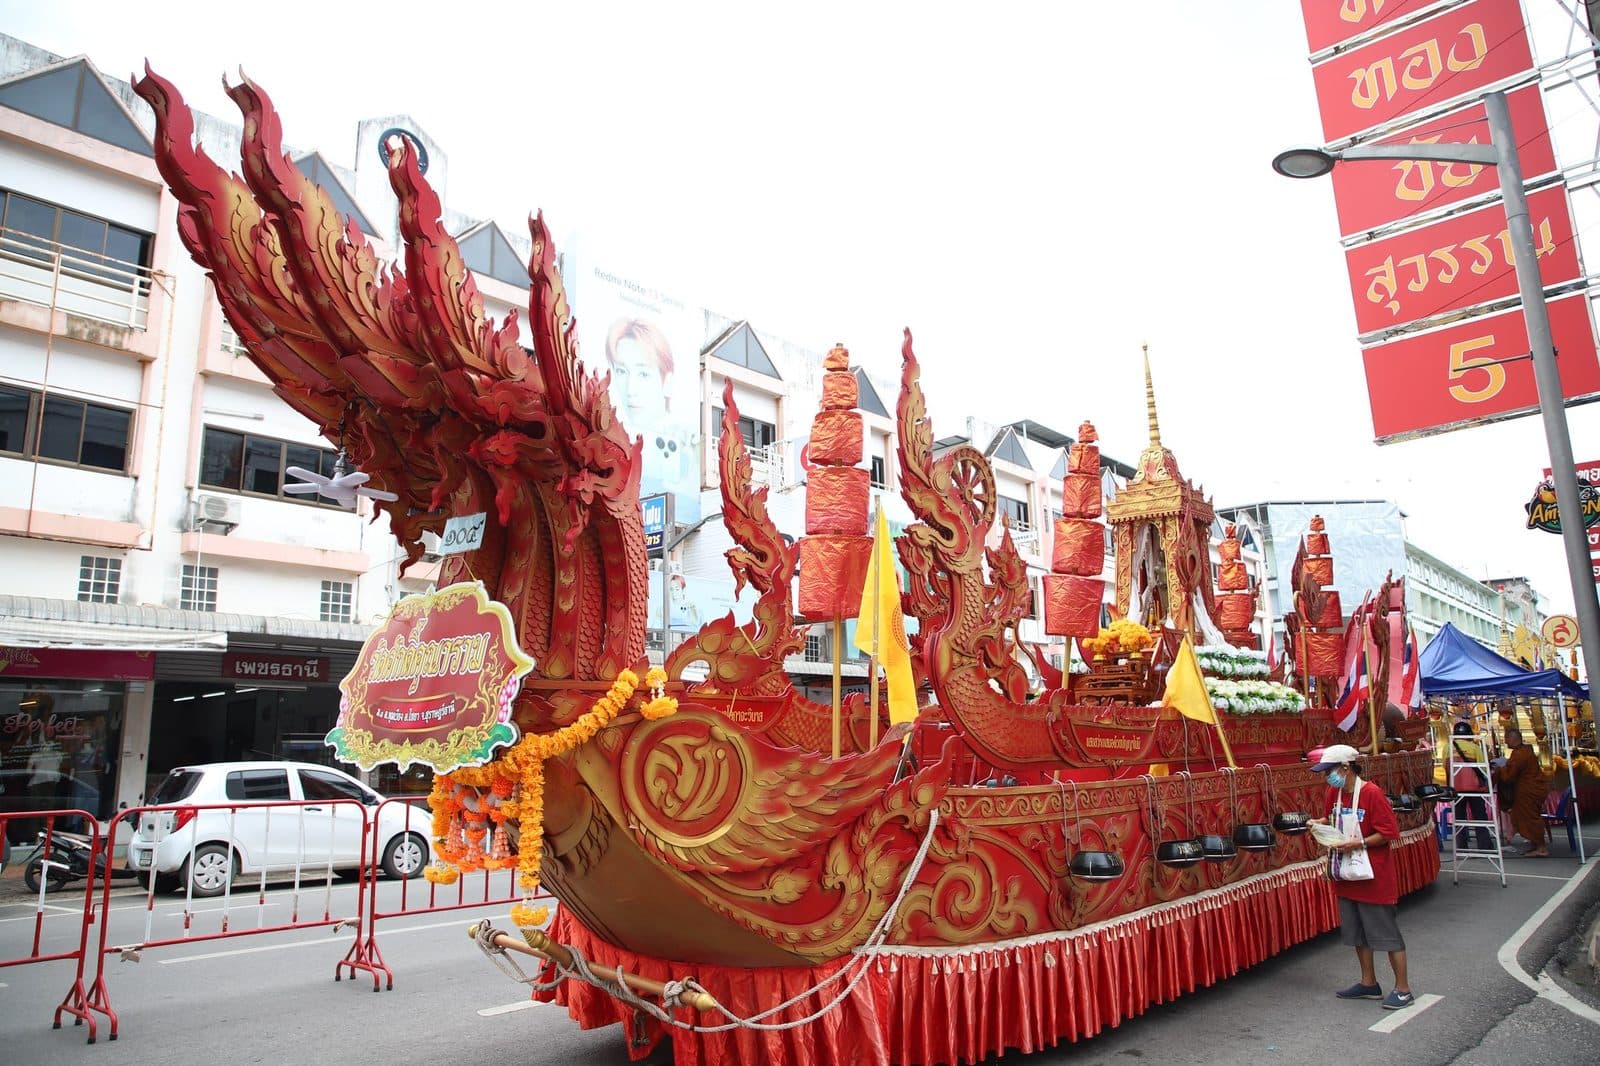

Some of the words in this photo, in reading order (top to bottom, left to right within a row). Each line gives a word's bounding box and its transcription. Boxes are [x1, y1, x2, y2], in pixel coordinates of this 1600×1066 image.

[624, 280, 646, 295] Note
[1448, 335, 1506, 403] 5
[235, 660, 319, 678] เพชรธานี
[3, 712, 85, 738] Perfect
